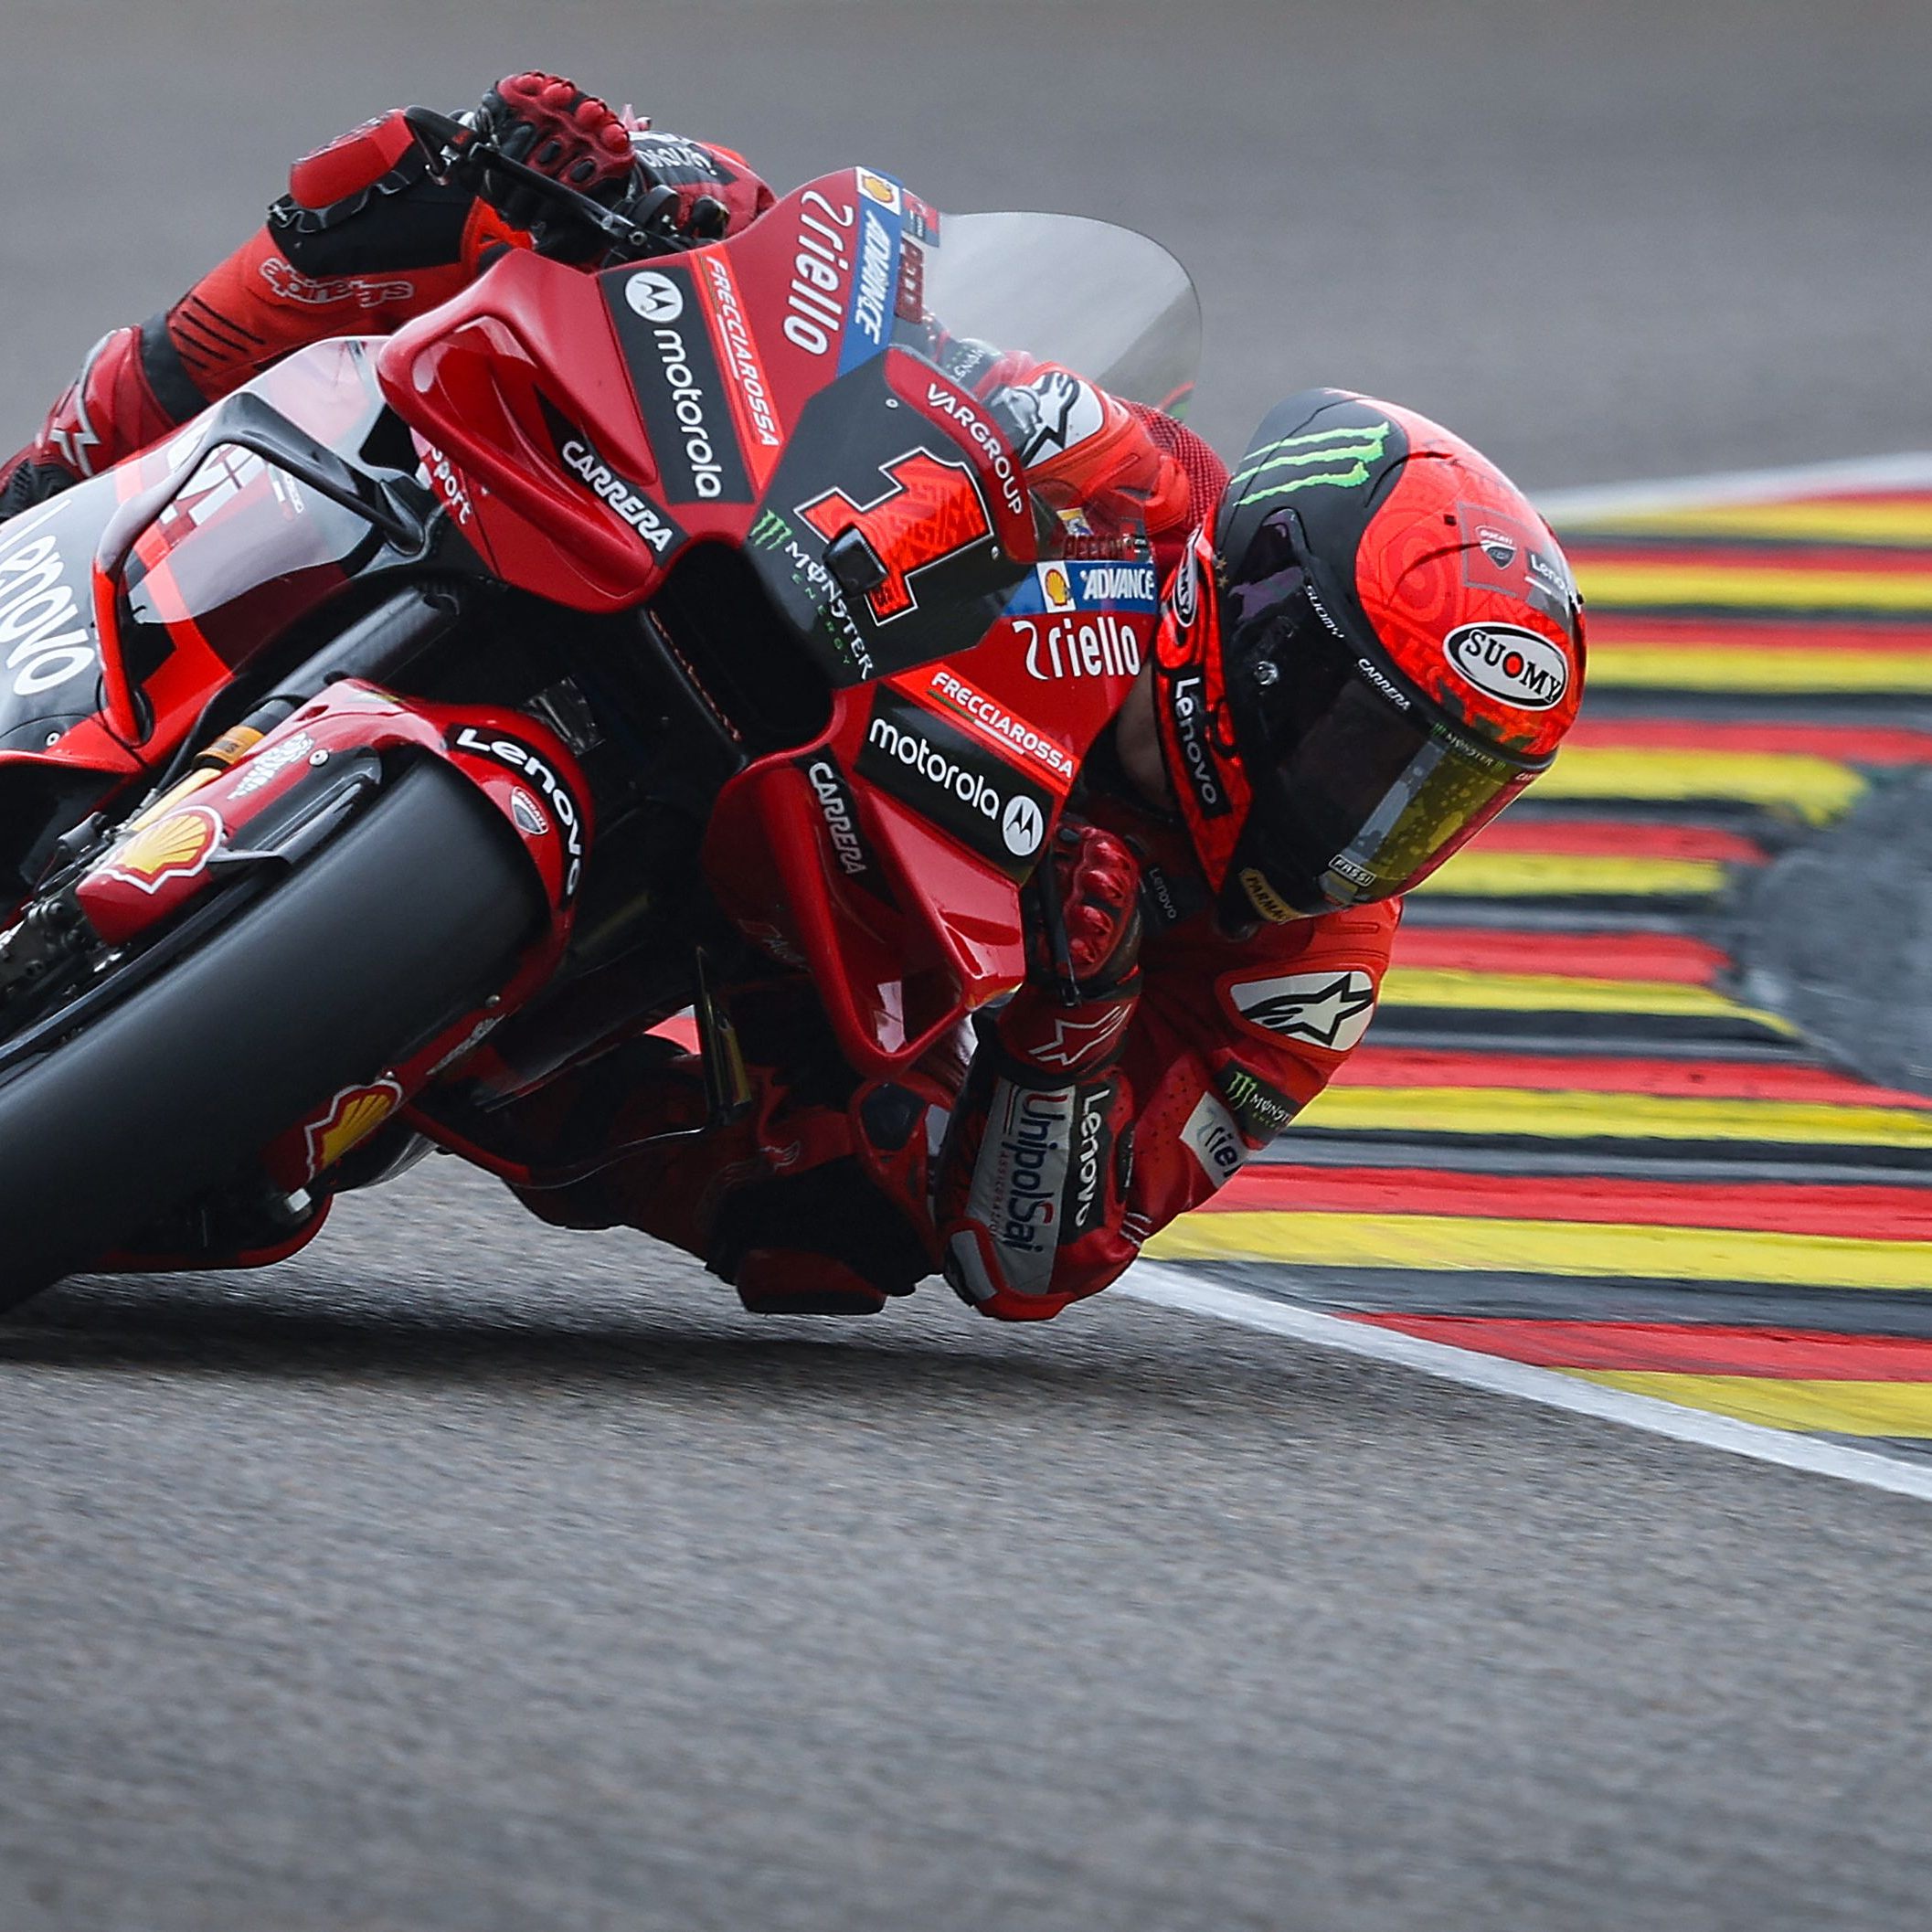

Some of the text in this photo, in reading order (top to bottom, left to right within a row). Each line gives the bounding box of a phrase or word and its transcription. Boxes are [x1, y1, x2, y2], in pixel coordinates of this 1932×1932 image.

[855, 210, 891, 345] ADVANCE
[653, 329, 723, 498] motorola
[706, 257, 780, 446] FRECCIAROSSA
[562, 441, 674, 552] CARRERA
[928, 383, 1024, 515] VARGROUP
[793, 447, 993, 627] 1
[1082, 568, 1154, 600] ADVANCE
[931, 672, 1076, 779] FRECCIAROSSA
[1357, 657, 1411, 711] CARRERA
[1464, 629, 1562, 704] SUOMY
[868, 717, 1001, 821] motorola
[1174, 677, 1217, 805] Lenovo
[457, 727, 583, 896] Lenovo
[808, 761, 868, 876] CARRERA
[1333, 858, 1374, 884] FASSI
[1001, 1092, 1069, 1253] UnipolSai
[1075, 1088, 1111, 1226] Lenovo
